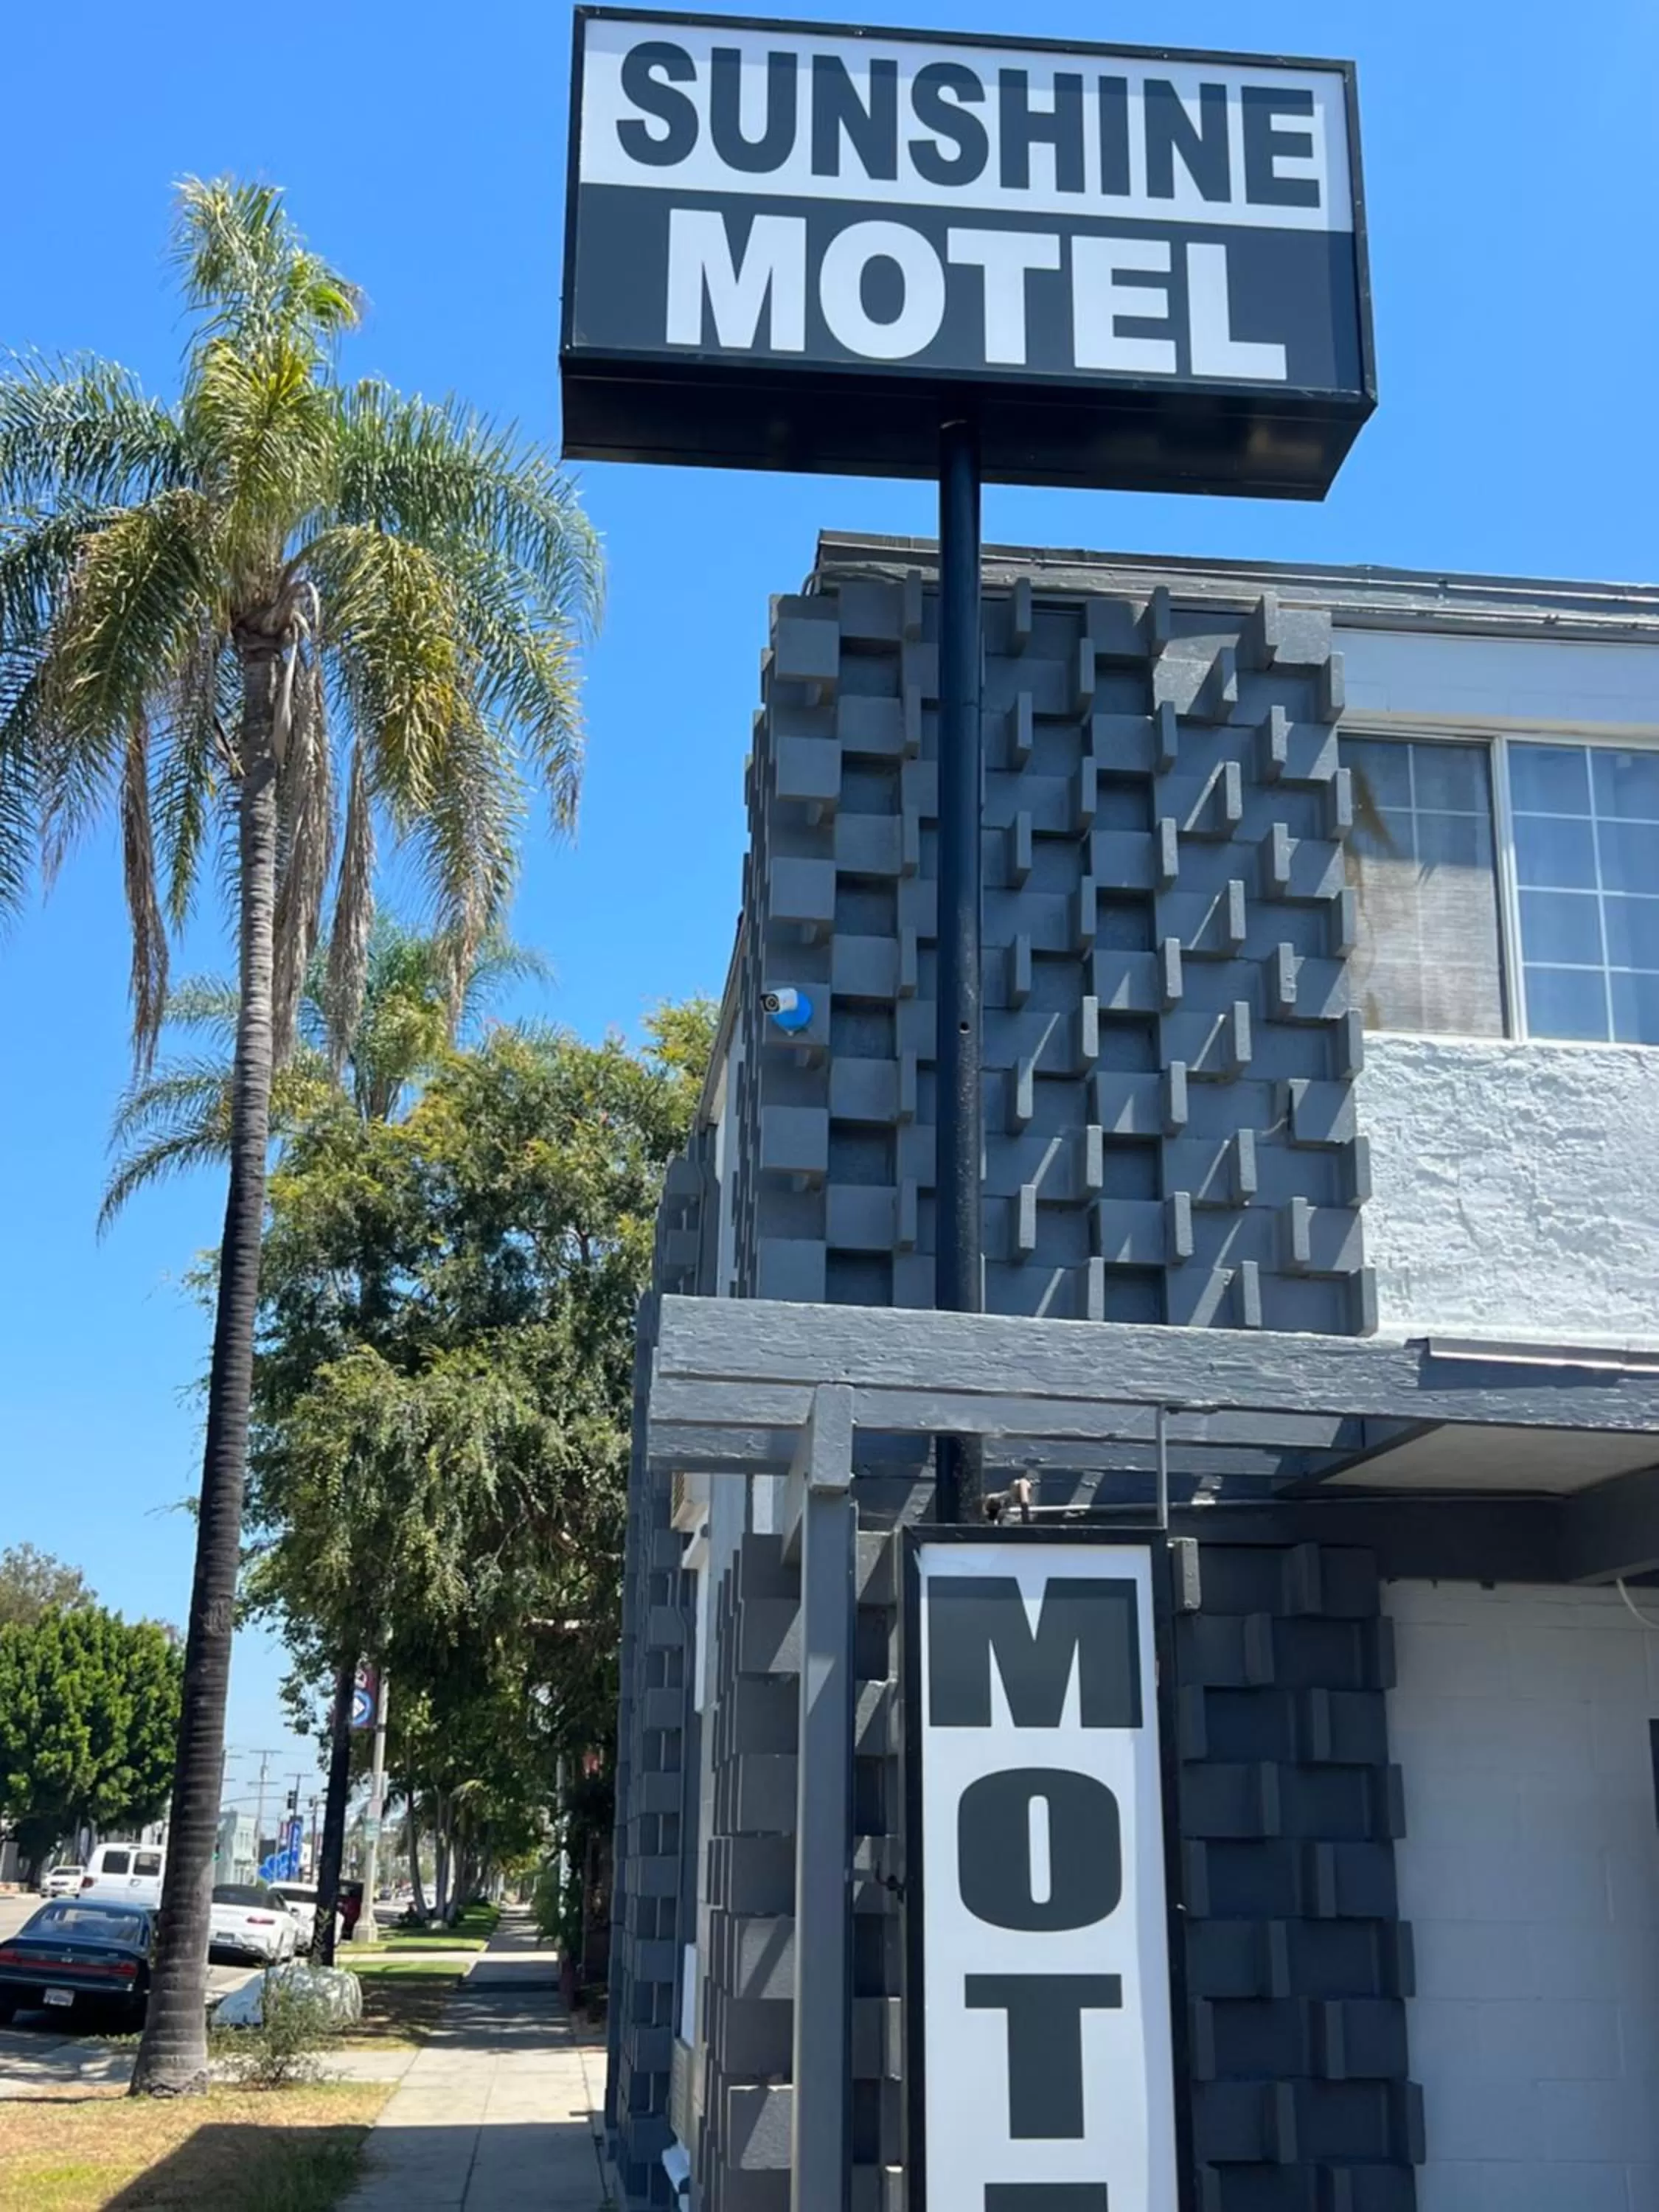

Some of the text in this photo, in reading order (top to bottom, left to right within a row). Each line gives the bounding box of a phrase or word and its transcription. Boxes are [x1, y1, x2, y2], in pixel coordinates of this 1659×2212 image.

[616, 41, 1321, 209] SUNSHINE
[666, 208, 1287, 381] MOTEL
[927, 1576, 1144, 2212] MOT
